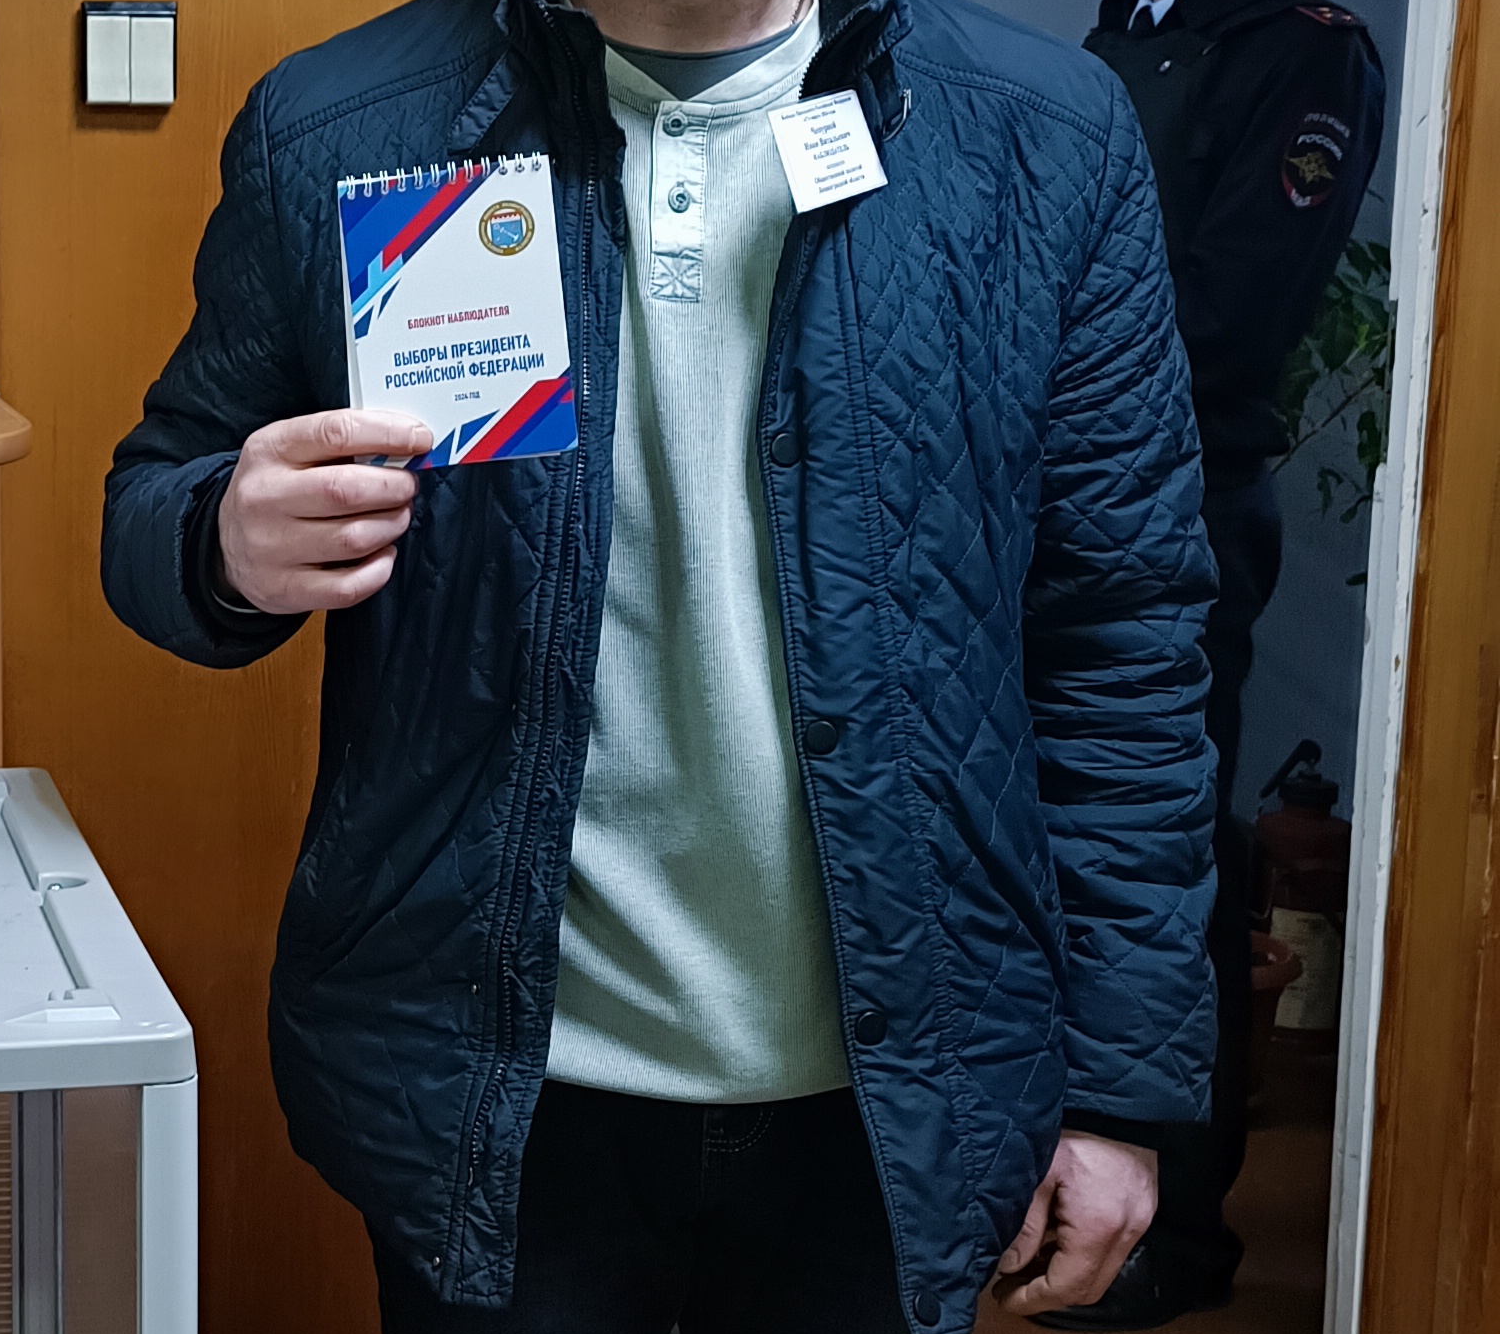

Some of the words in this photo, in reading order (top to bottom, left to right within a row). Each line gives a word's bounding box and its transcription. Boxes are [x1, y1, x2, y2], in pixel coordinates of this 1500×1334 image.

[407, 314, 446, 330] БЛОКНОТ
[447, 305, 511, 324] НАБЛЮДАТЕЛЯ
[393, 345, 448, 367] ВЫБОРЫ
[451, 333, 531, 359] ПРЕЗИДЕНТА
[385, 362, 465, 389] РОССИЙСКОЙ
[468, 353, 545, 377] ФЕДЕРАЦИИ
